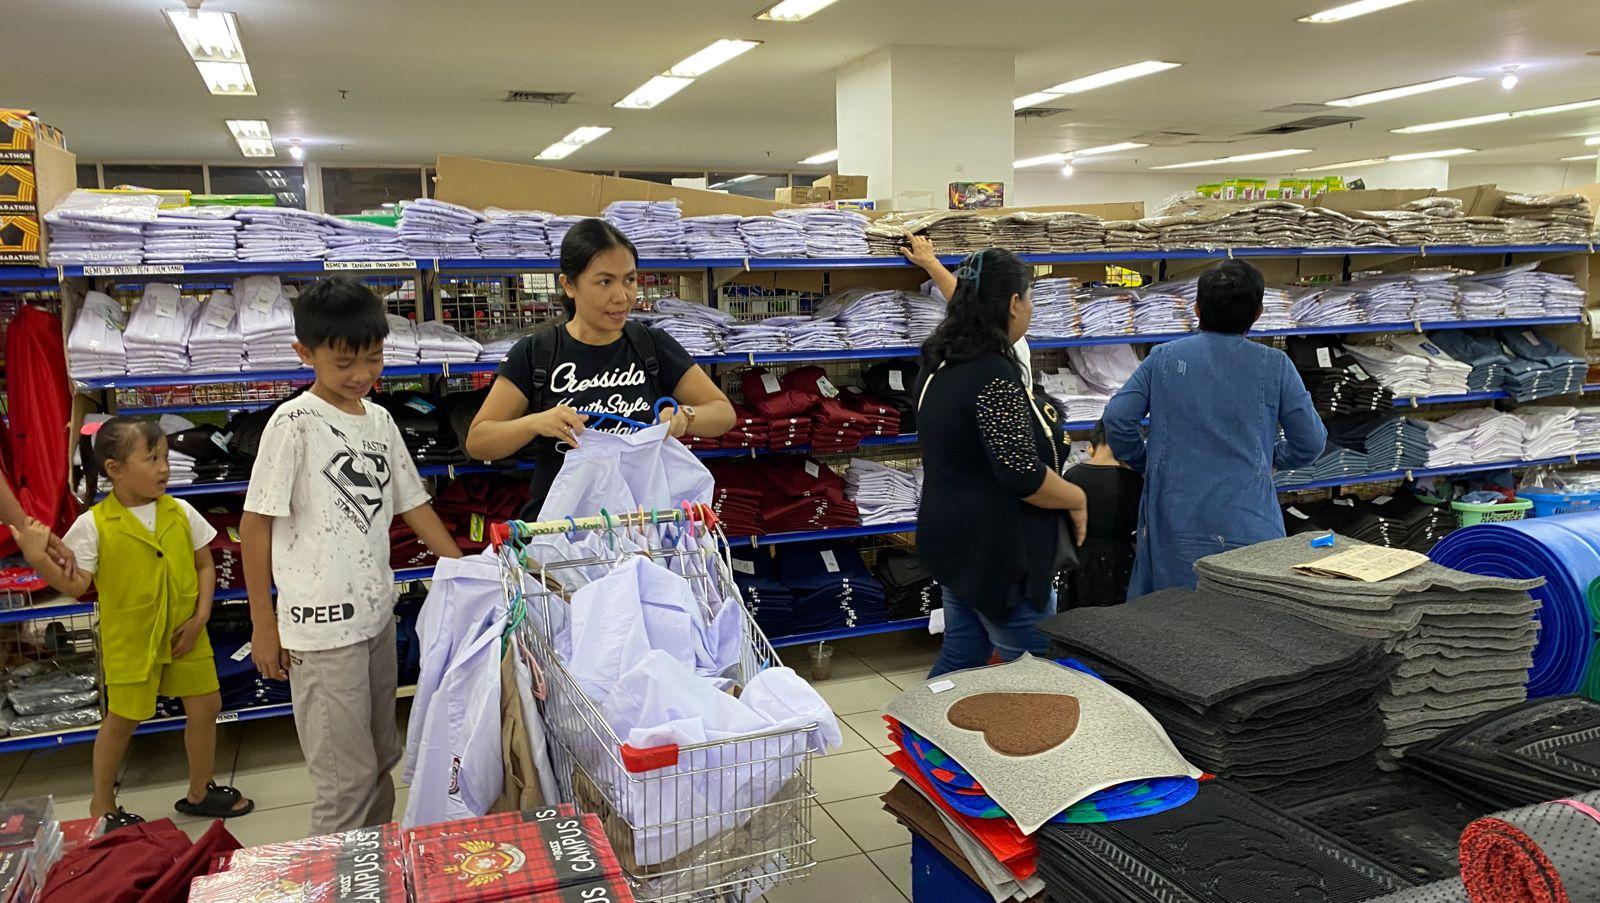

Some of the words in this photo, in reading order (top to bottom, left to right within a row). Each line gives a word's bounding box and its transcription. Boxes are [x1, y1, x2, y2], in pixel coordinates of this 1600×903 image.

[550, 362, 646, 393] Cressida
[290, 603, 355, 624] SPEED
[556, 820, 596, 872] CAMPUS
[354, 853, 380, 903] AMPUS
